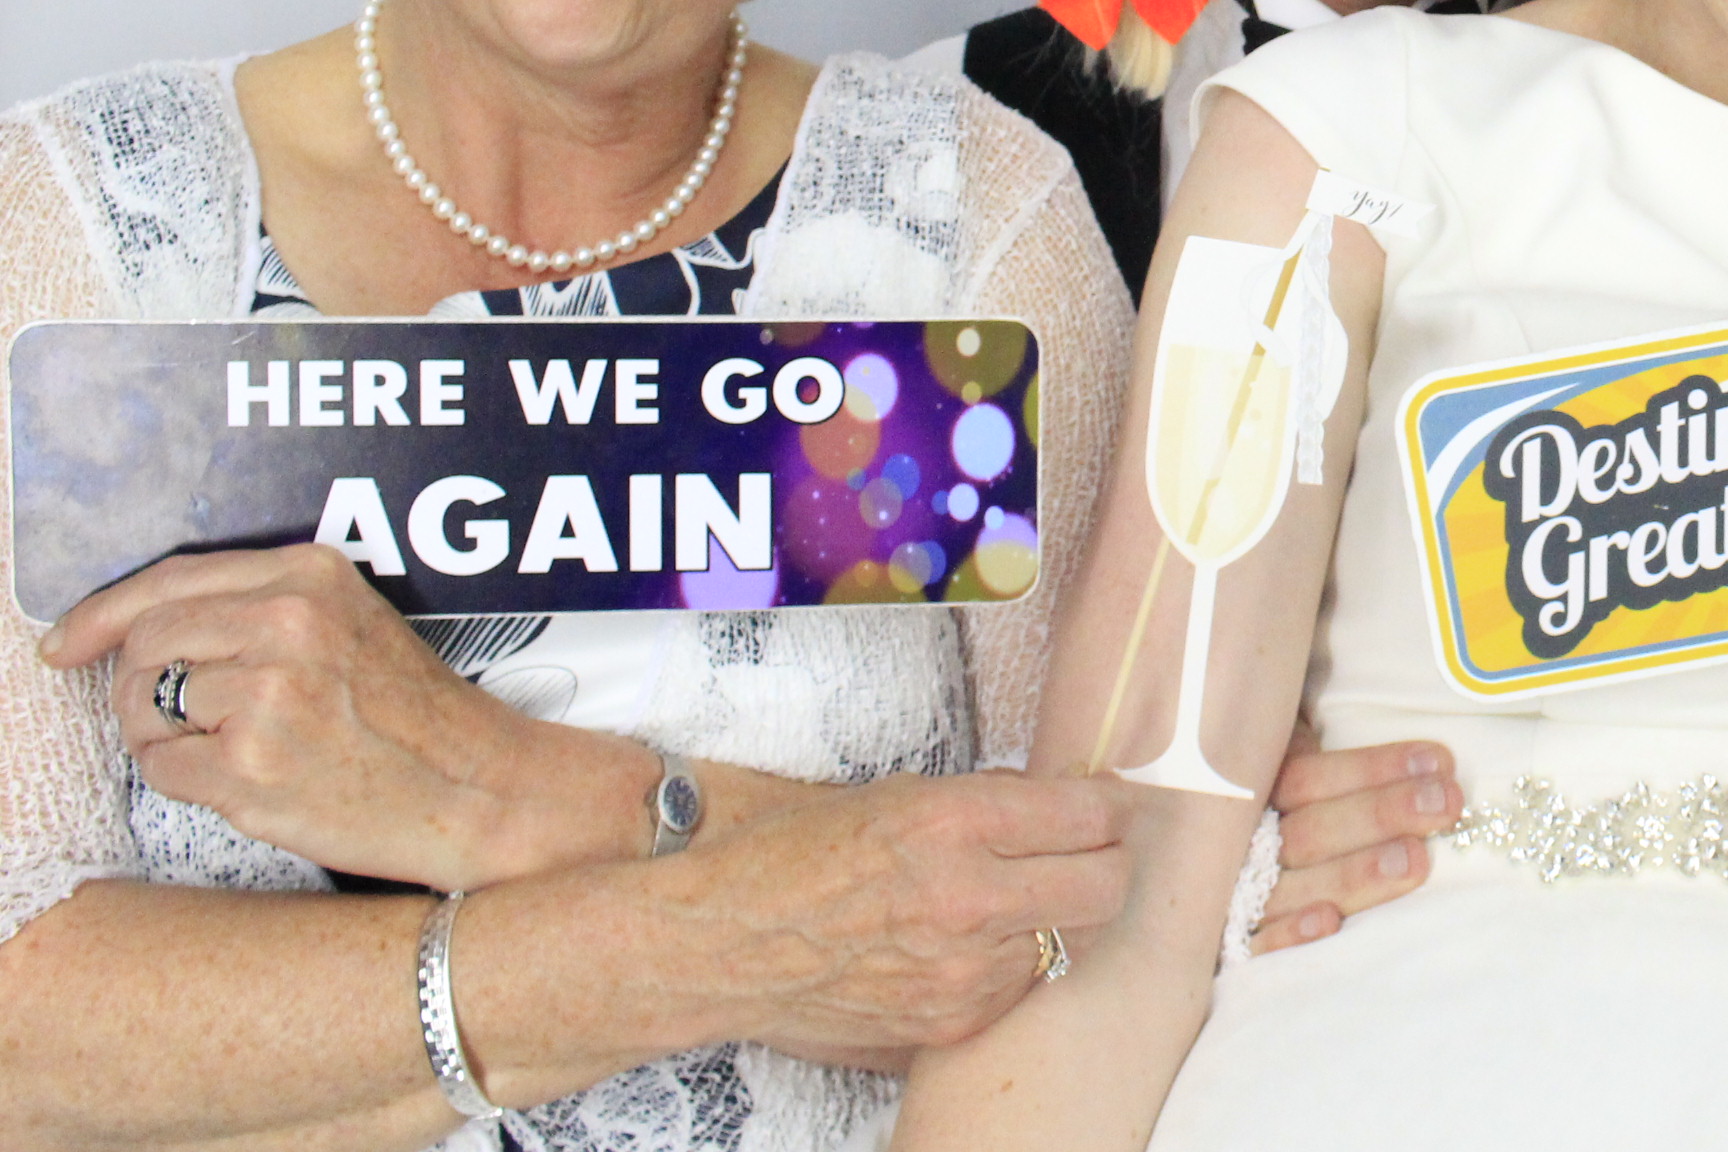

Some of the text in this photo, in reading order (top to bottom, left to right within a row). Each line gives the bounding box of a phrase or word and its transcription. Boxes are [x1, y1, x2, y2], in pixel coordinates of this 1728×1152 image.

[226, 357, 844, 428] HERE WE GO
[313, 473, 773, 576] AGAIN
